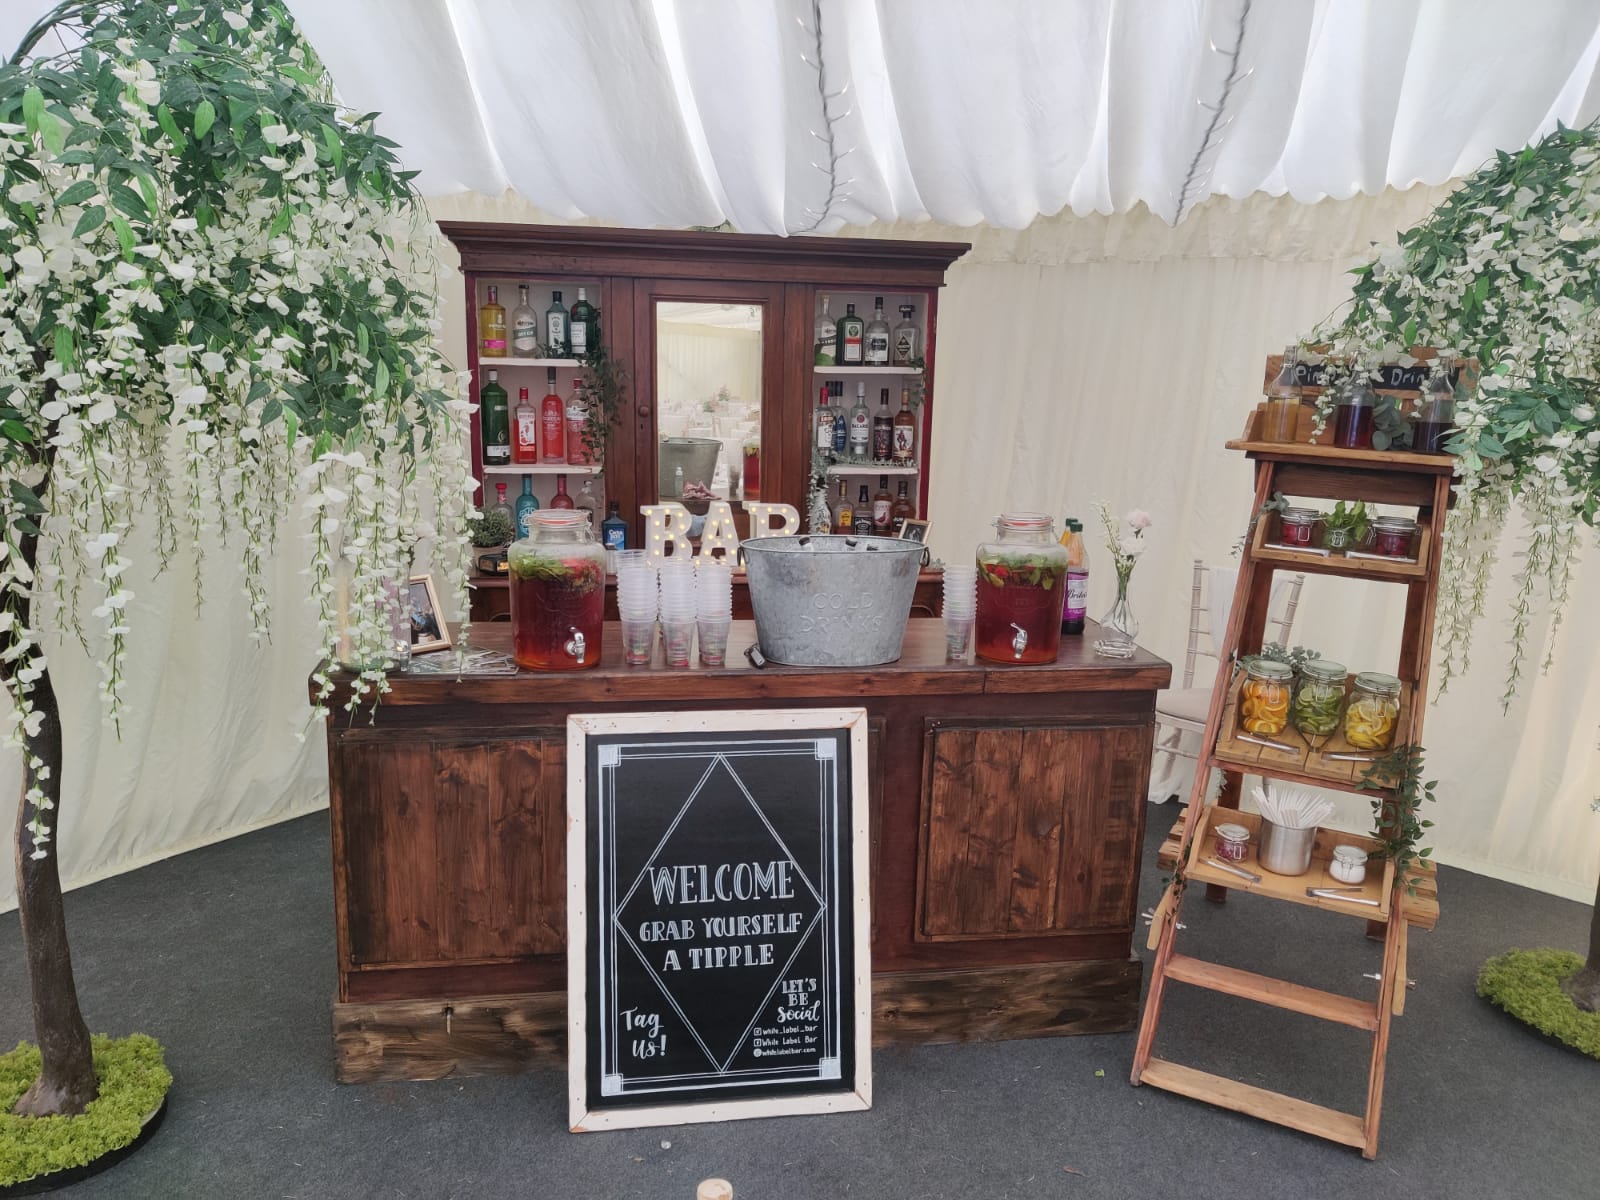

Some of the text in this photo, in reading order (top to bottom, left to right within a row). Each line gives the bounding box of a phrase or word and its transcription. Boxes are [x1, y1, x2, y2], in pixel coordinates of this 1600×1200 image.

[1391, 368, 1425, 386] Drin
[650, 860, 796, 906] WELCOME
[639, 912, 803, 943] GRAB YOURSELF
[662, 943, 775, 972] A TIPPLE
[781, 977, 817, 994] LET'S
[776, 999, 821, 1023] Social
[788, 992, 809, 1007] BE
[619, 1006, 665, 1039] Tag
[804, 1035, 818, 1044] Bar
